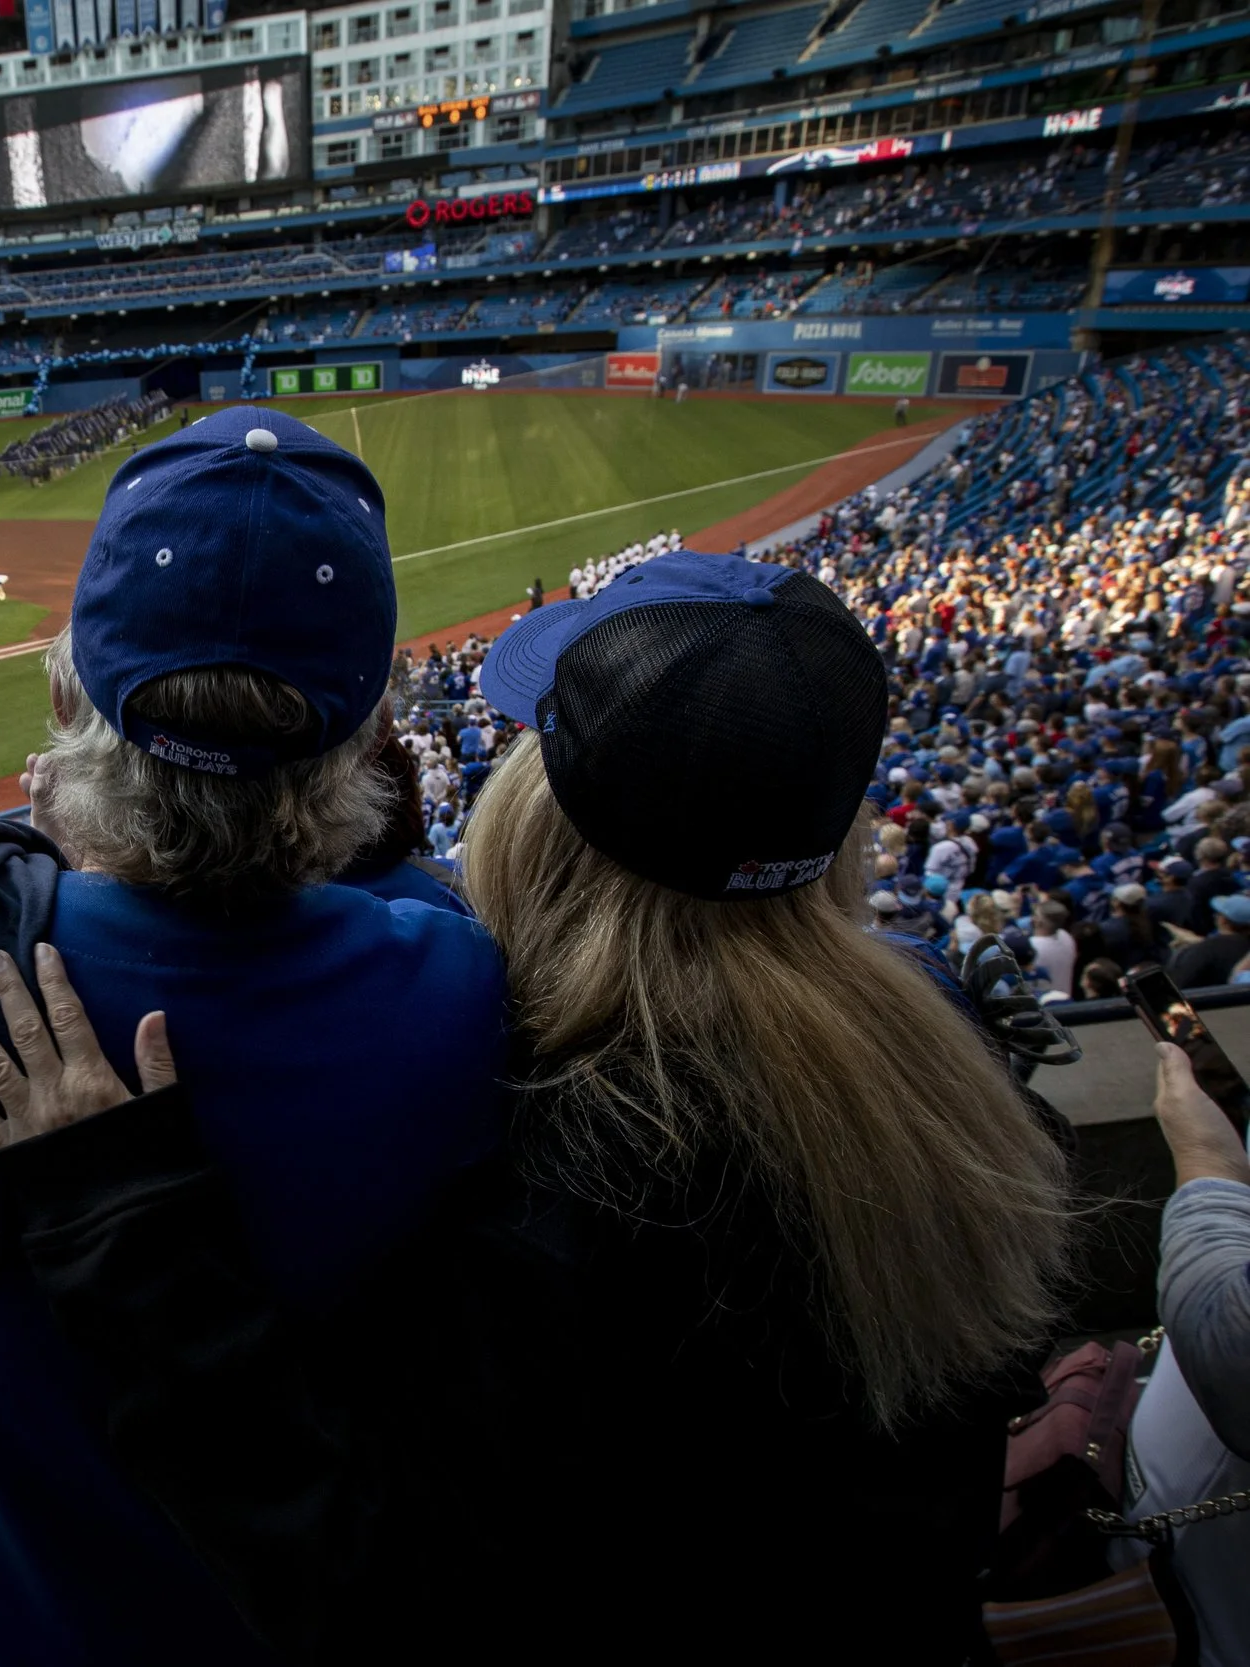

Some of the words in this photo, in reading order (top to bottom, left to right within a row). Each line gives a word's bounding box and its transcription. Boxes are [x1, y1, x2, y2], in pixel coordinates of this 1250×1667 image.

[1043, 106, 1104, 137] HOME
[435, 191, 533, 222] ROGERS
[96, 228, 160, 251] WESTJET
[793, 322, 828, 341] PIZZA
[281, 374, 297, 389] TD
[317, 372, 333, 387] TD
[355, 370, 372, 385] TD
[462, 368, 500, 384] HOME
[851, 360, 925, 388] Sobeys
[149, 741, 190, 767] BLUE
[192, 760, 238, 775] JAYS
[170, 740, 231, 763] TORONTO
[726, 872, 787, 890] BLUE
[788, 861, 831, 886] JAY
